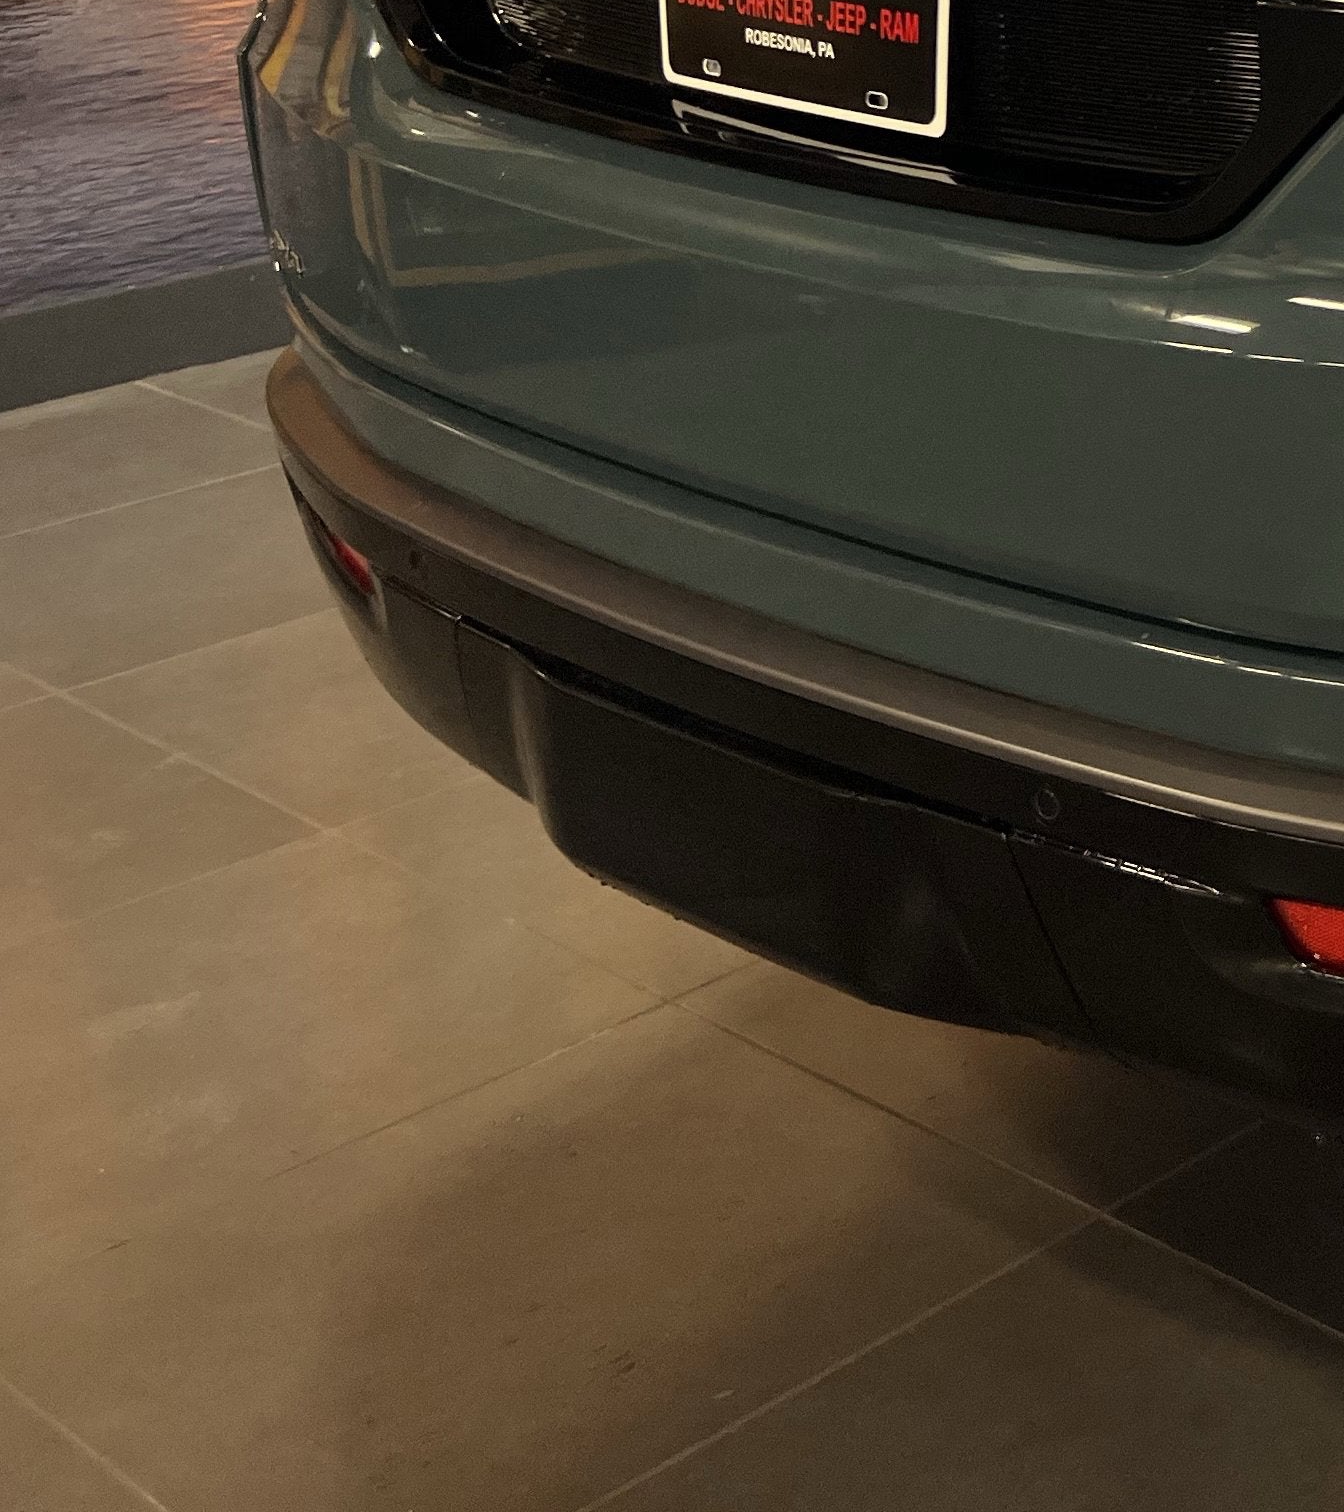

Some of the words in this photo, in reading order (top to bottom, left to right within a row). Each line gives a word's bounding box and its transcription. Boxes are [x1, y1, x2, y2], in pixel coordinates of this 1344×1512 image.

[825, 0, 867, 36] JEEP
[879, 8, 920, 44] RAM
[745, 27, 816, 58] ROBESONIA,
[817, 41, 836, 59] PA
